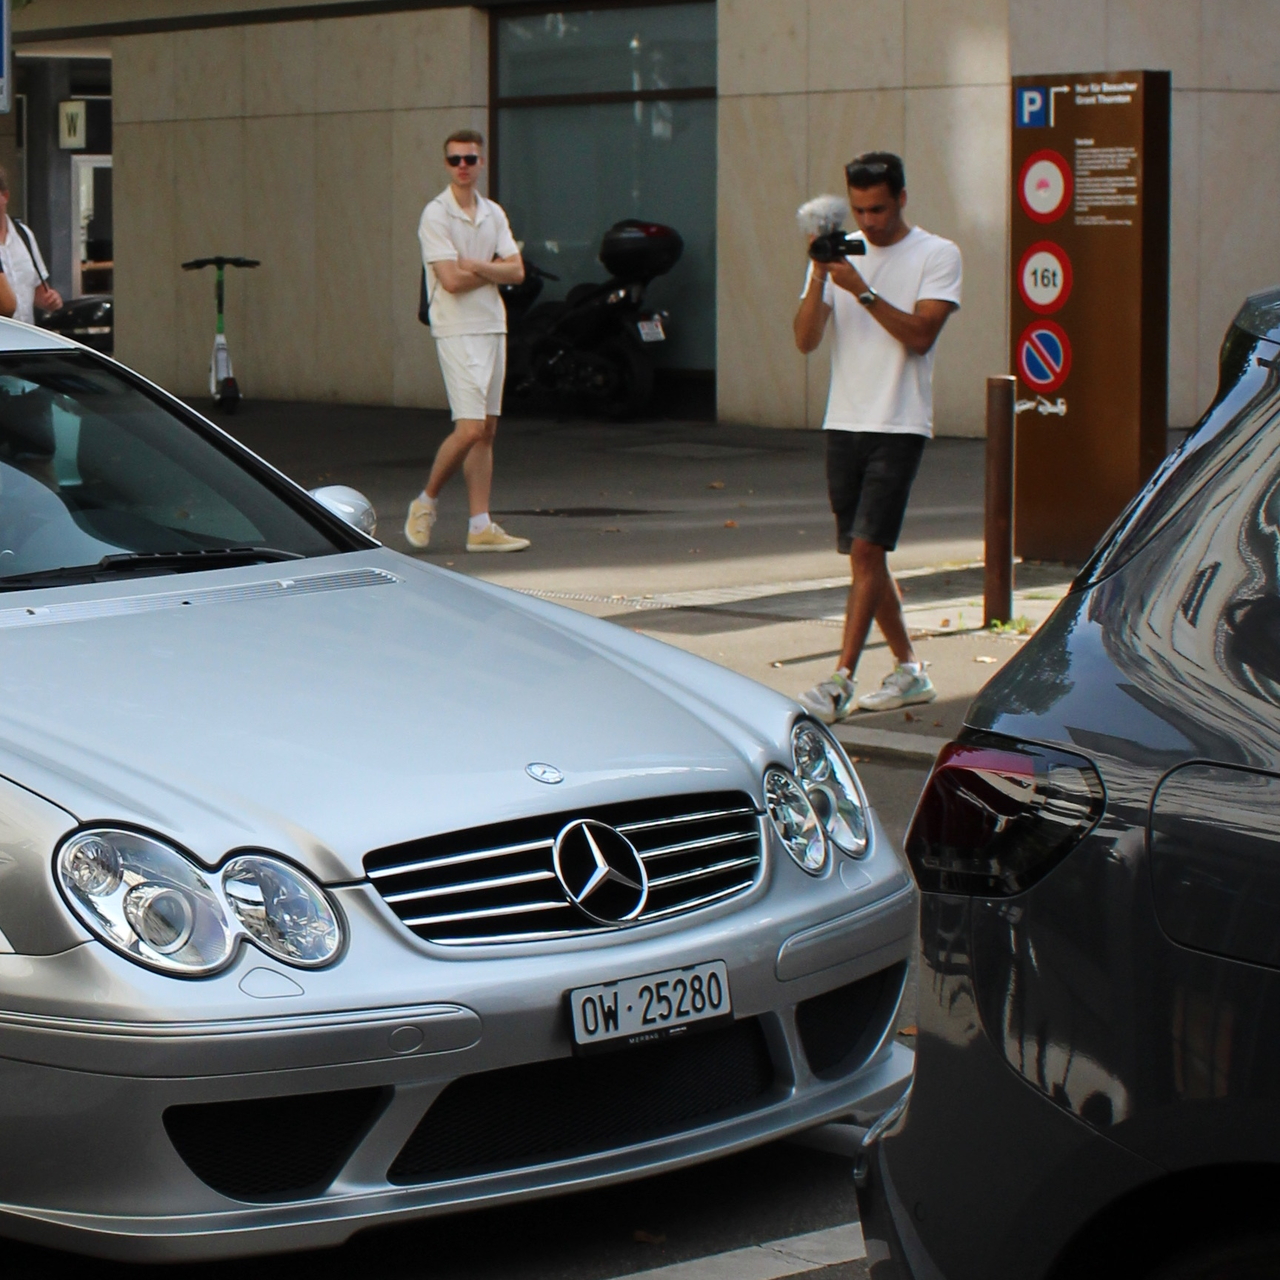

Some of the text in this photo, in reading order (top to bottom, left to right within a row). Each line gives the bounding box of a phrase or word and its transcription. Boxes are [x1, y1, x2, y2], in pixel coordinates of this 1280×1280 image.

[1023, 90, 1043, 123] P
[65, 112, 79, 138] W
[1031, 268, 1058, 288] 16t
